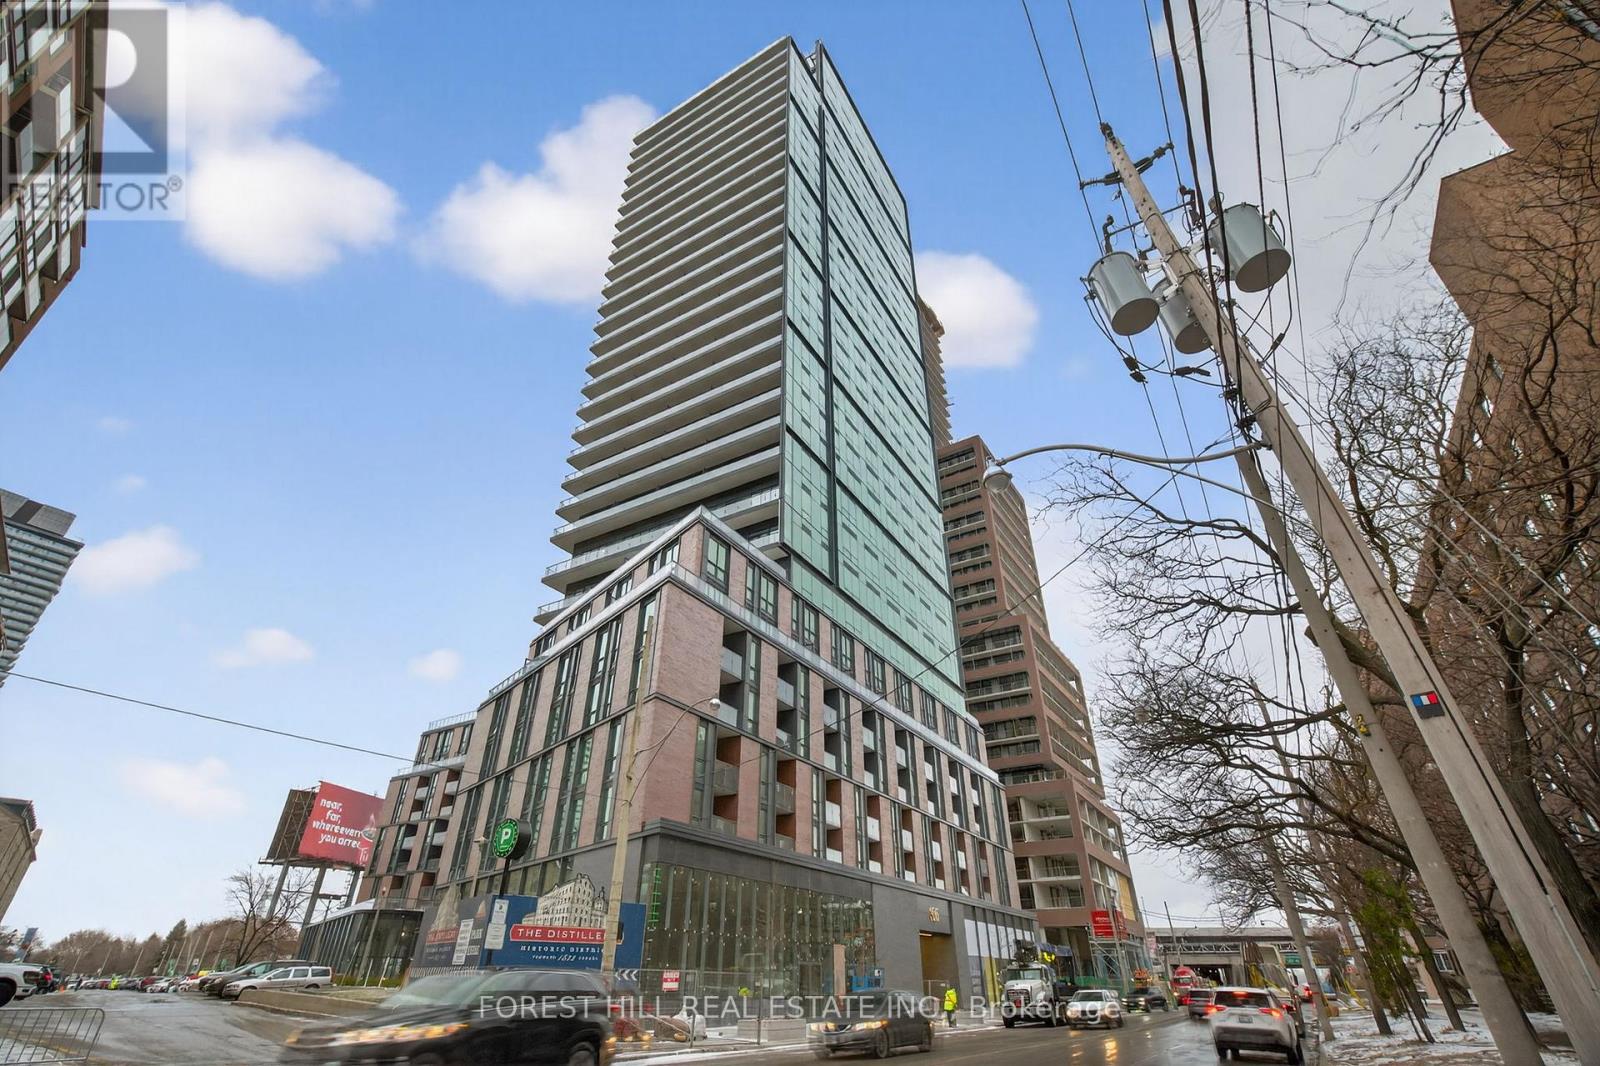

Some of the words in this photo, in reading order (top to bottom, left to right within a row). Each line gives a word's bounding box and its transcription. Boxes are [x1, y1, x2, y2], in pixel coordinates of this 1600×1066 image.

[318, 834, 336, 844] you
[517, 928, 542, 938] THE
[547, 930, 606, 940] DISTILLE
